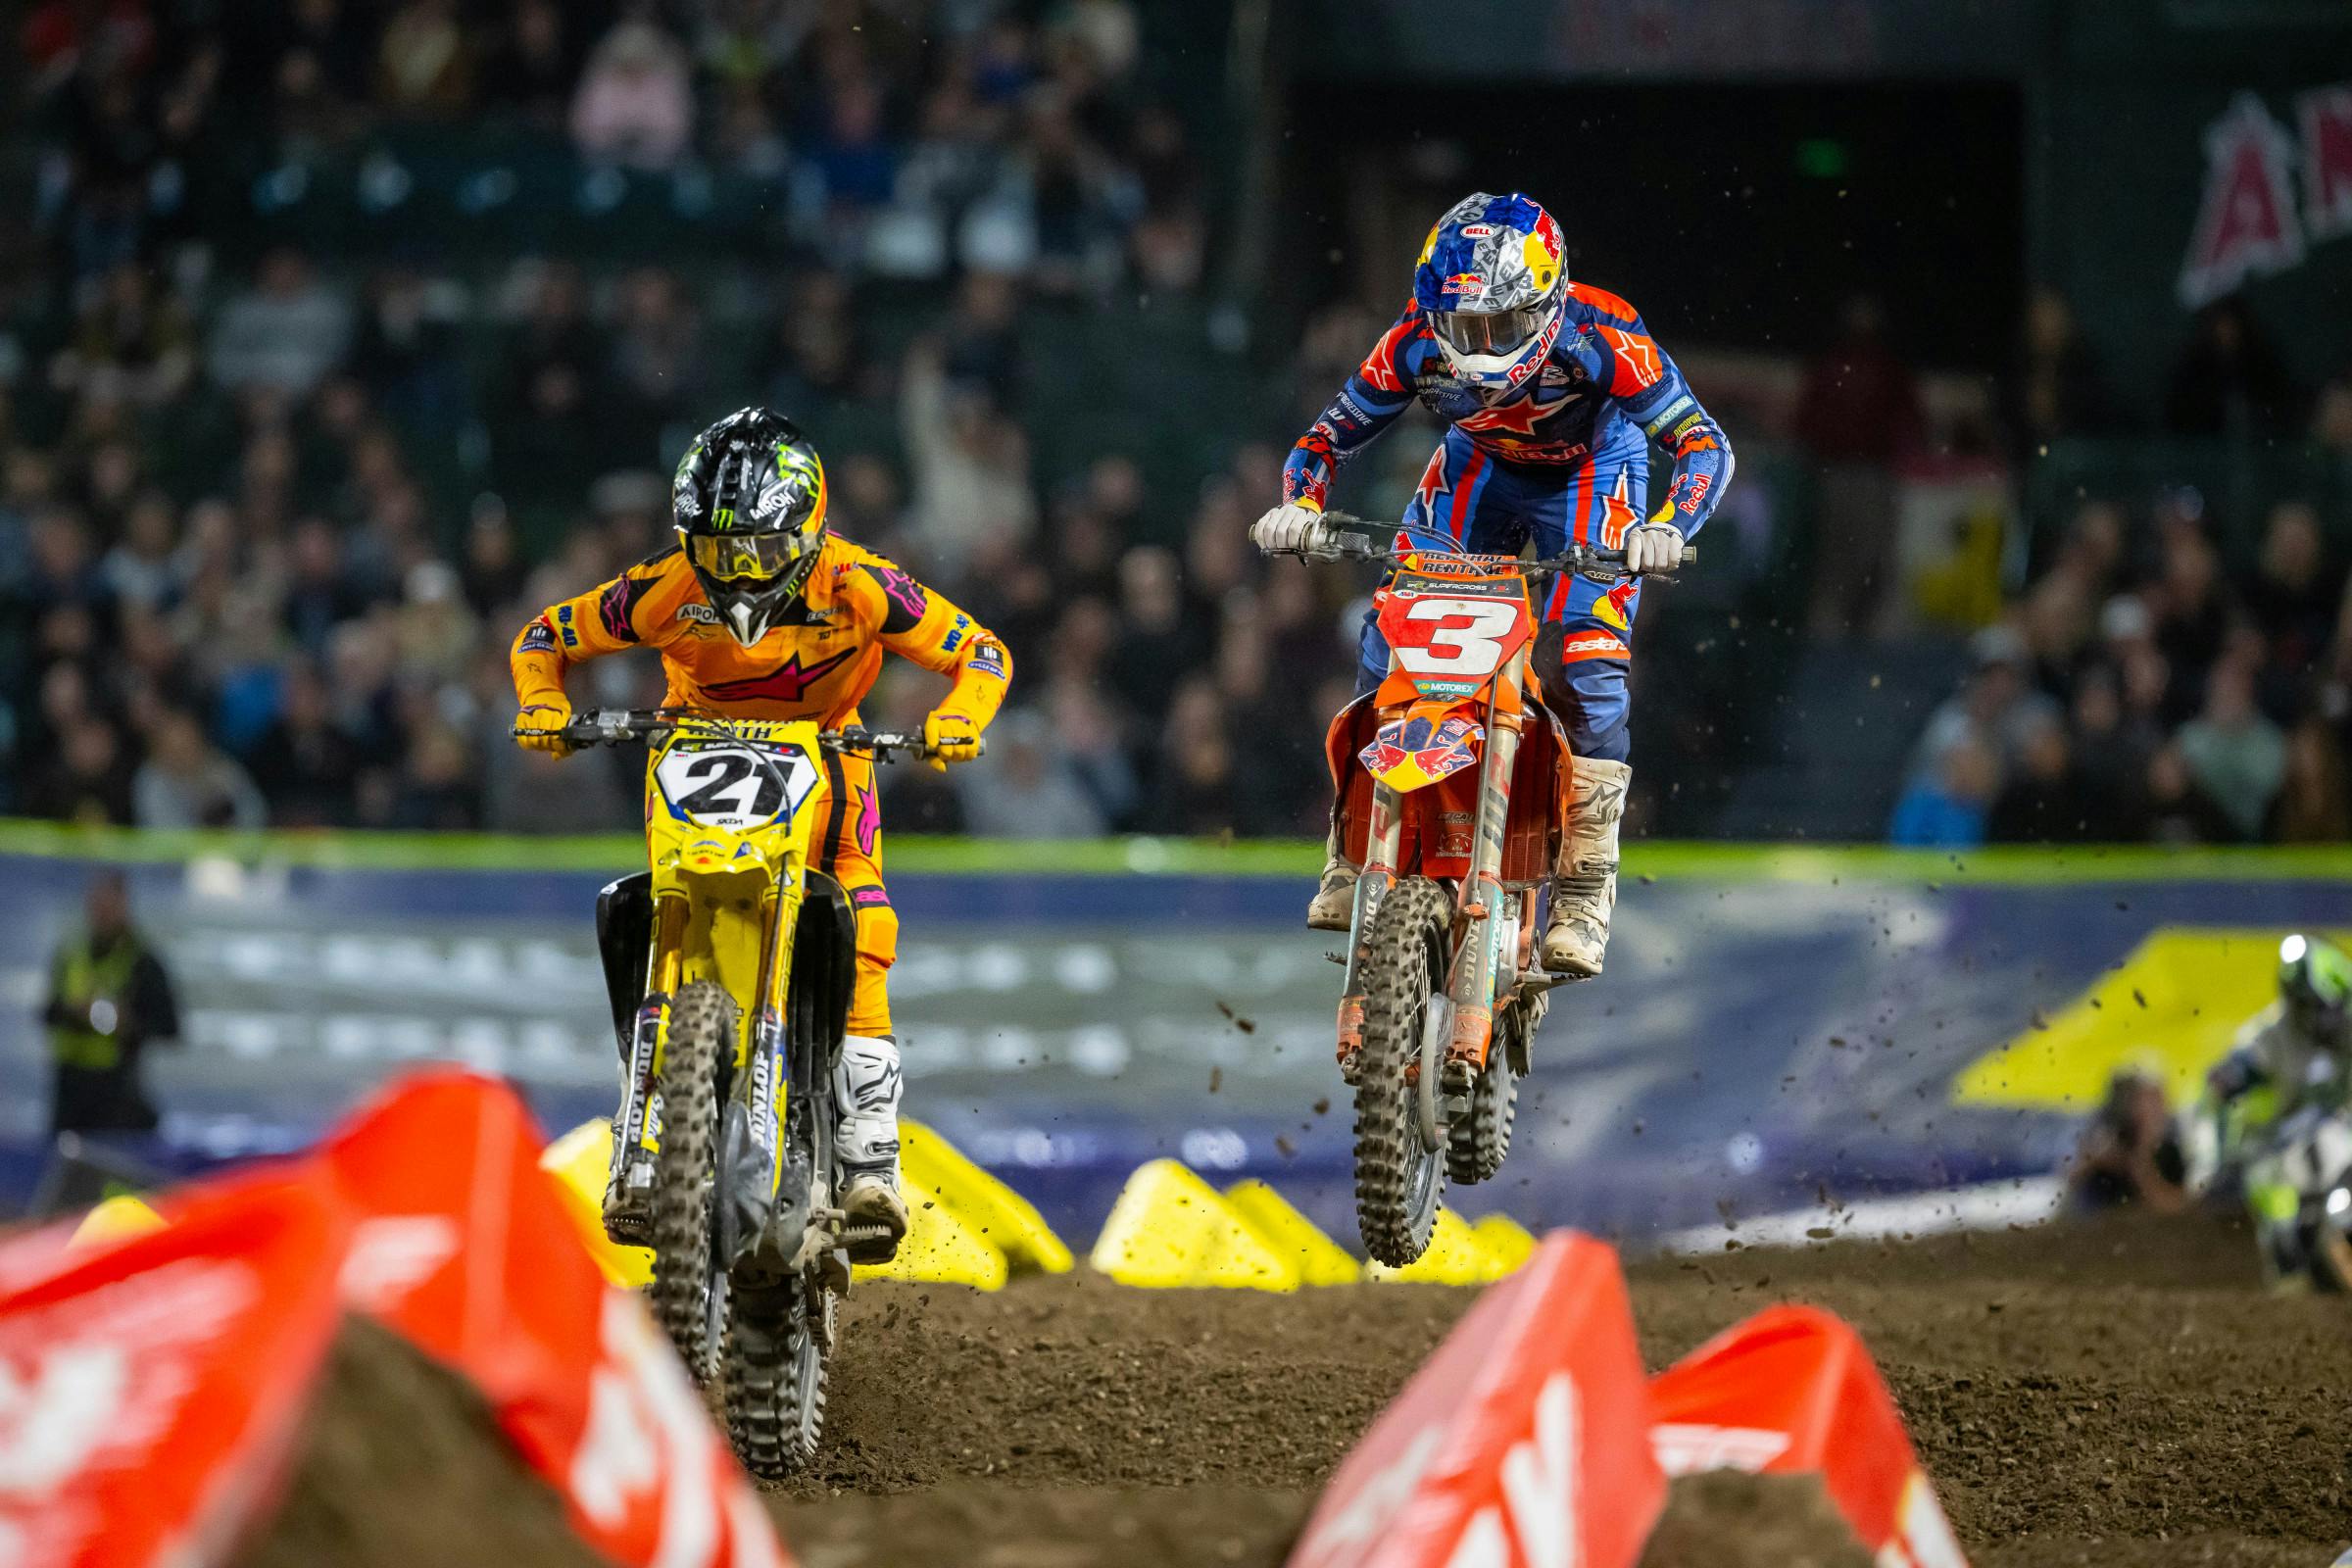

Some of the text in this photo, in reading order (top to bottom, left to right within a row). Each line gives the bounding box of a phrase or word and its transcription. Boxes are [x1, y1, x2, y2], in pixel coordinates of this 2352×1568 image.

[1464, 226, 1492, 236] BELL
[1428, 582, 1488, 591] SUPERCROSS
[1394, 599, 1519, 676] 3
[1430, 683, 1474, 693] MOTOREX
[676, 755, 796, 815] 21
[1488, 899, 1504, 974] MOTOREX
